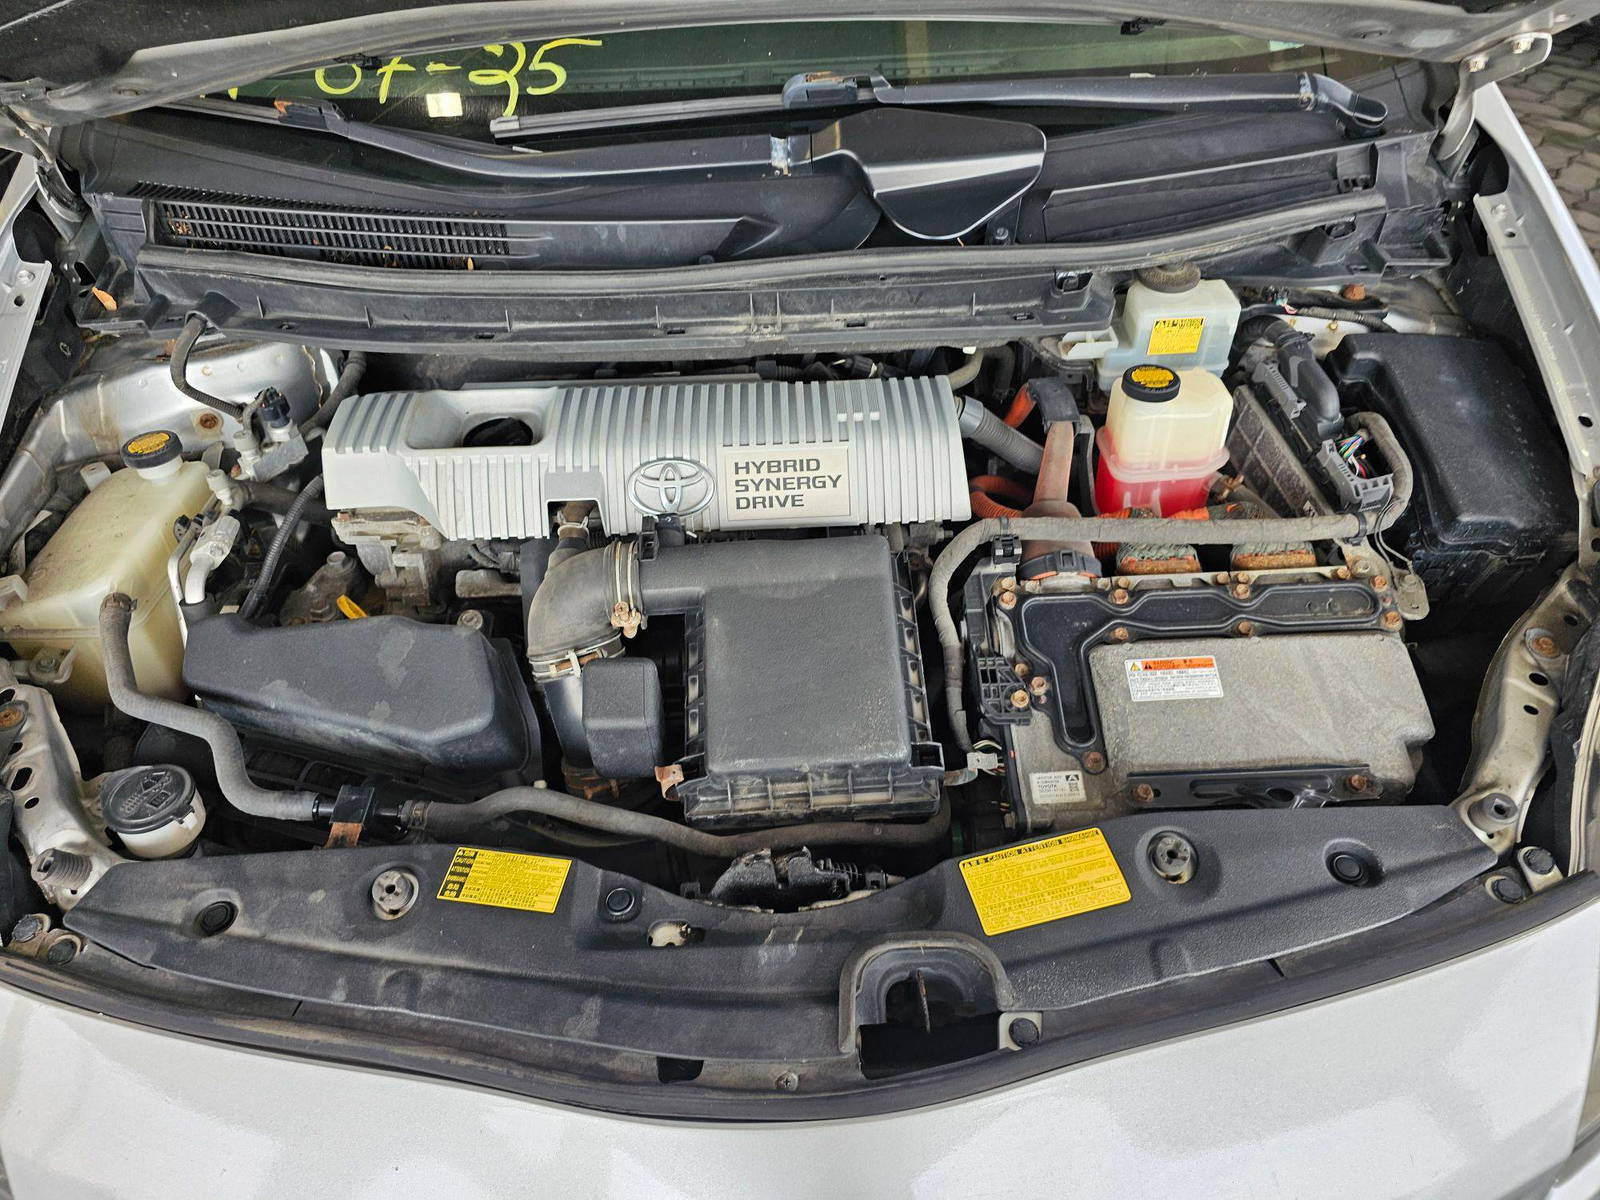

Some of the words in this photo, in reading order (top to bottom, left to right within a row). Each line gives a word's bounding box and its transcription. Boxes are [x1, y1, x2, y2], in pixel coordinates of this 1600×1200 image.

[734, 458, 821, 475] HYBRID
[735, 474, 842, 493] SYNERGY
[735, 494, 805, 510] DRIVE
